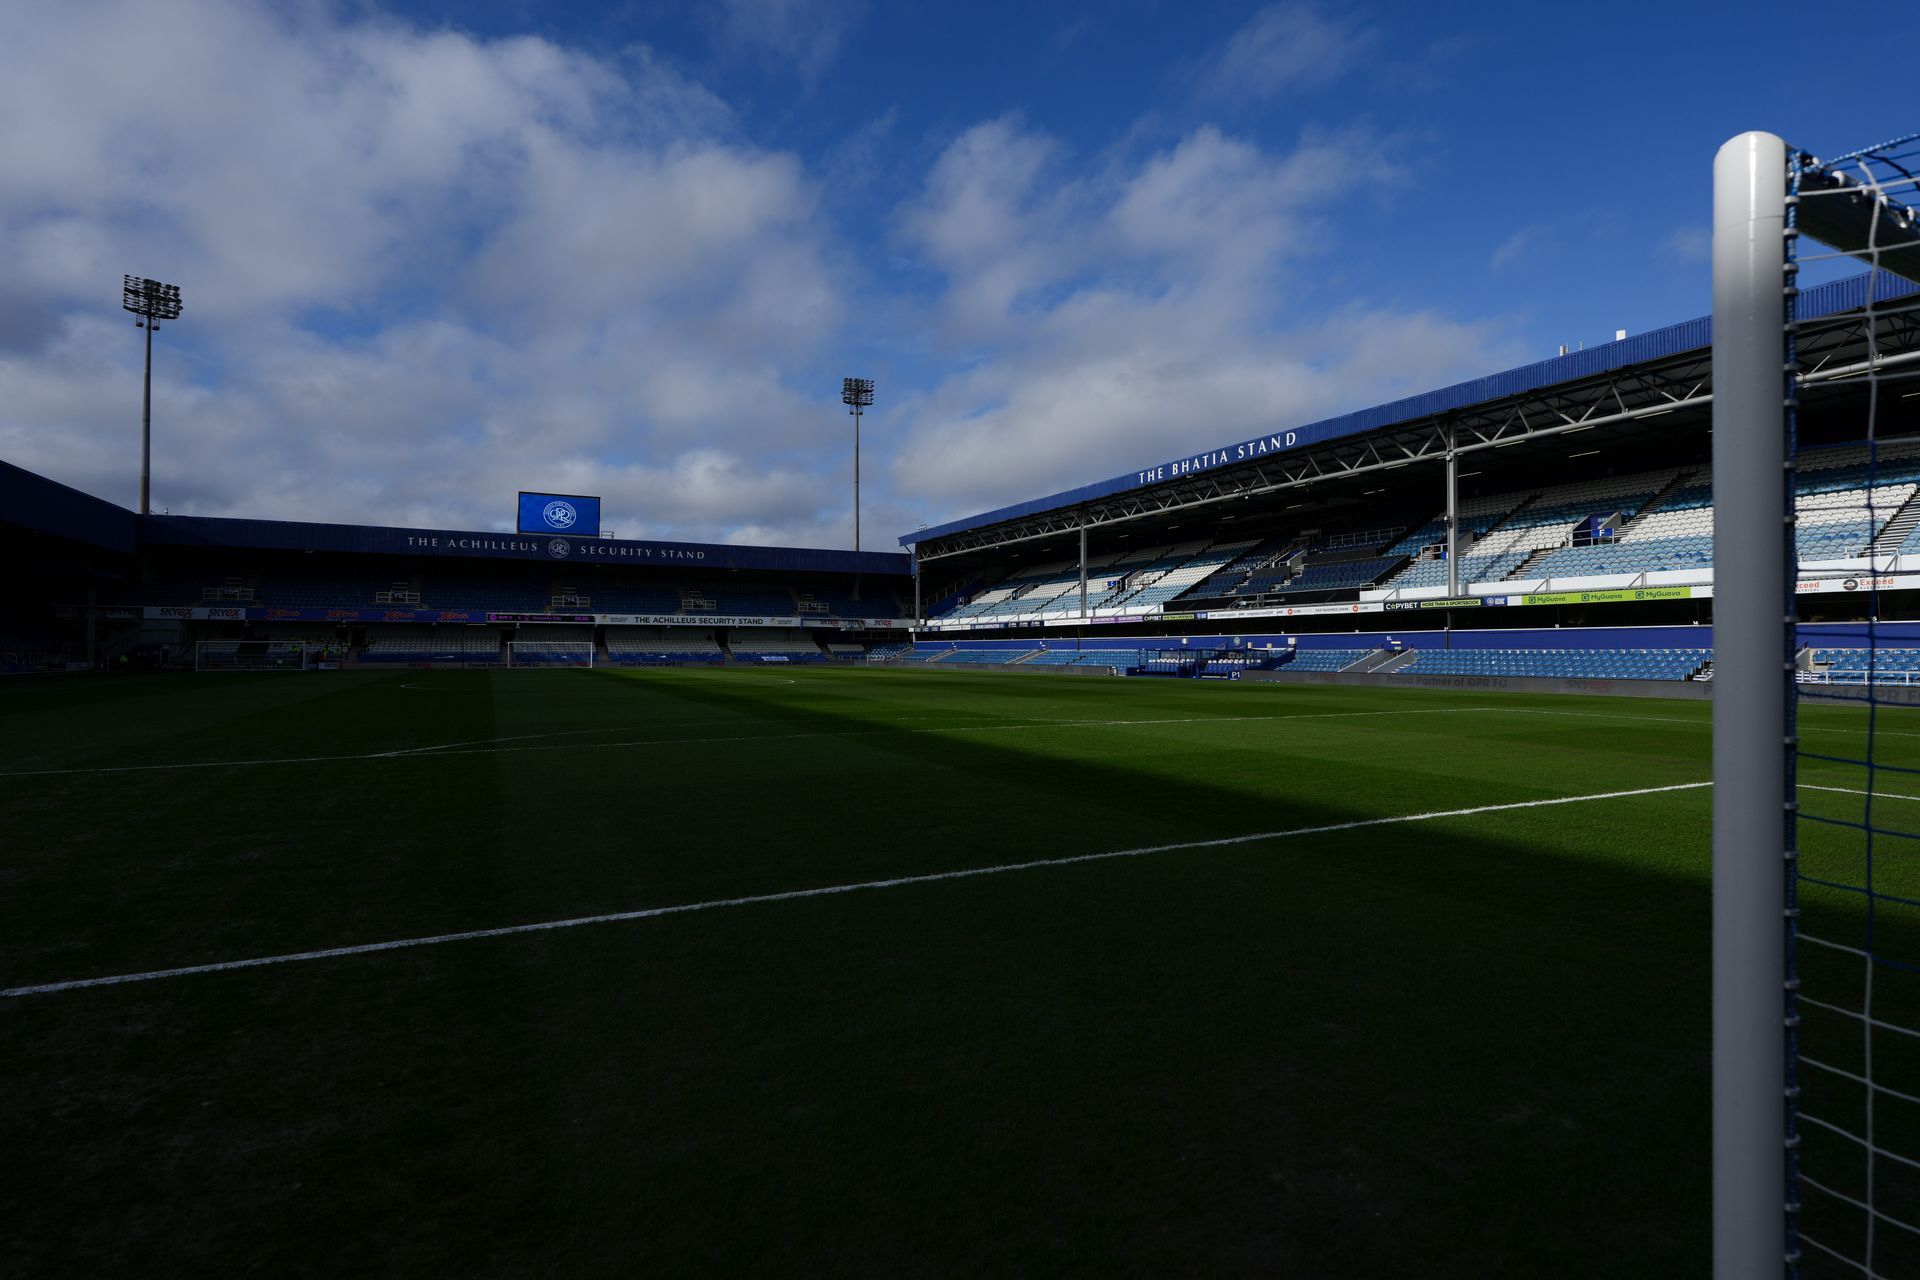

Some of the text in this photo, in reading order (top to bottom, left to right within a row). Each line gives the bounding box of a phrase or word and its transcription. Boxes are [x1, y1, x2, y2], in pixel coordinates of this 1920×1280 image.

[1139, 432, 1296, 484] THE BHATIA STAND
[407, 537, 538, 552] THE ACHILLEUS
[580, 545, 705, 560] SECURITY STAND
[1591, 593, 1623, 601] MyGuava
[1646, 590, 1681, 598] MyGuava
[1385, 602, 1418, 610] COPYBET
[634, 616, 650, 624] THE
[652, 616, 697, 624] ACHILLEUS
[1386, 675, 1508, 688] Proud Partner of QPR FC
